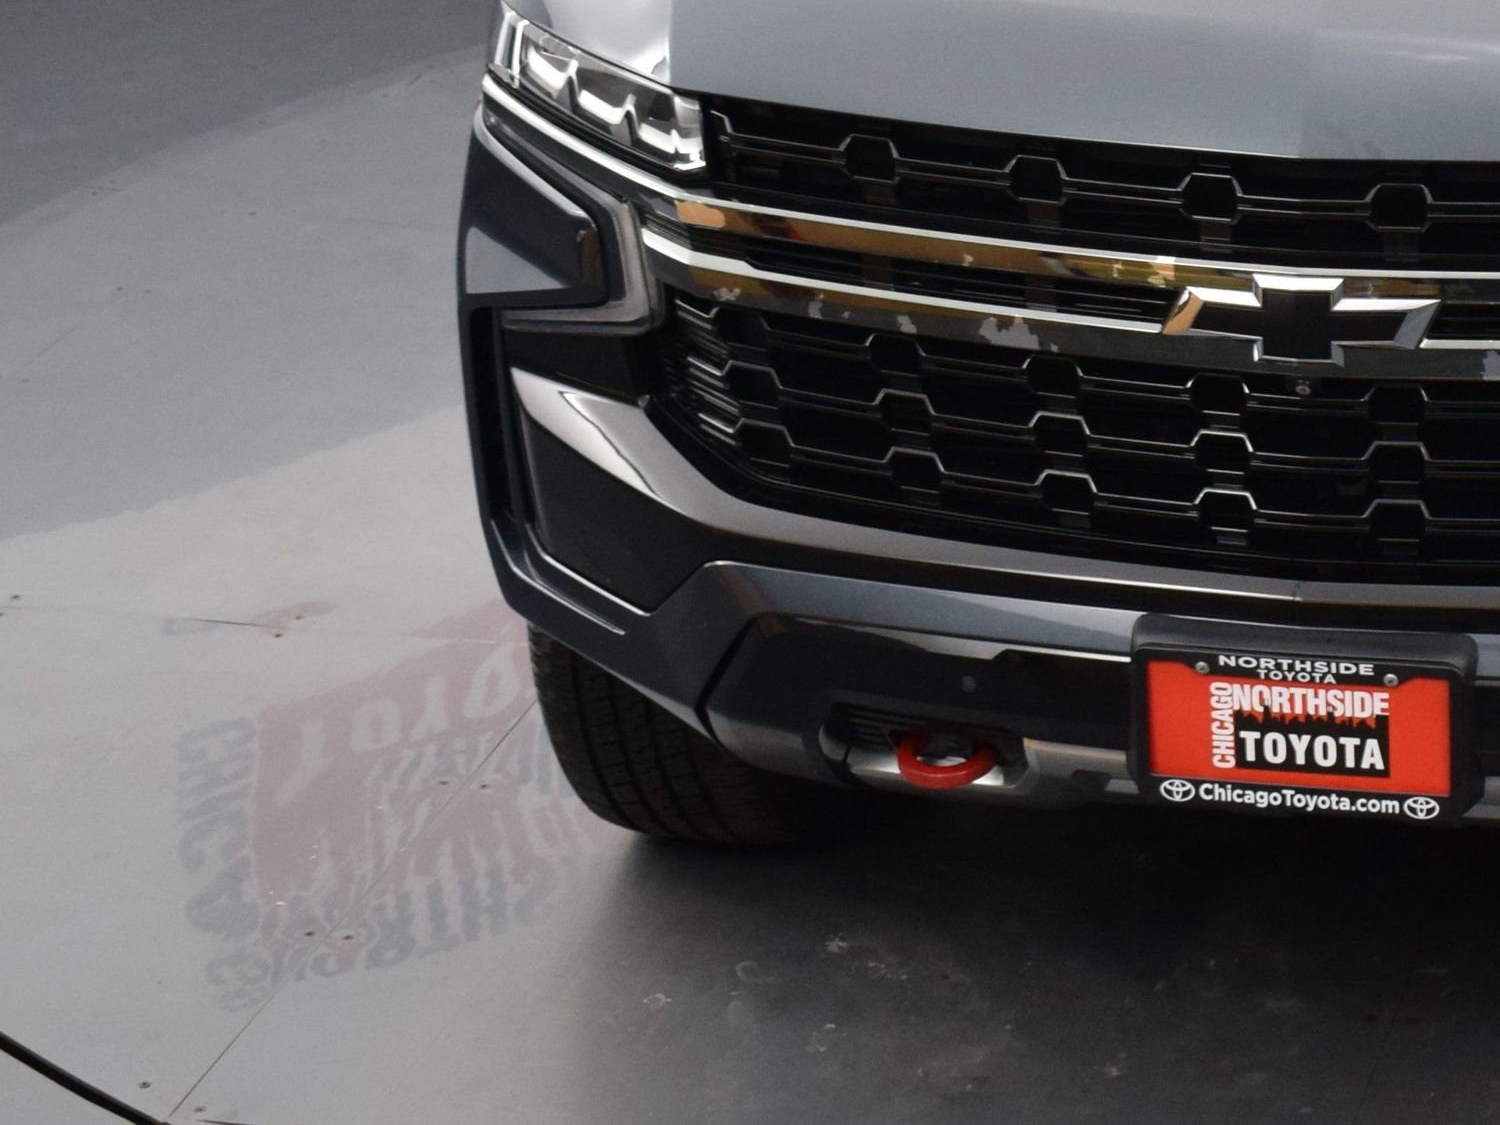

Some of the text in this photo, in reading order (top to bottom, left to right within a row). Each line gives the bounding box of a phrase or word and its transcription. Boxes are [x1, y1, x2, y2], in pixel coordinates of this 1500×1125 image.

[1218, 655, 1374, 676] NORTHSIDE
[1257, 669, 1336, 684] TOYOTA
[1232, 683, 1390, 718] NORTHSIDE
[1209, 682, 1236, 769] CHICAGO
[1239, 730, 1385, 770] TOYOTA
[1199, 783, 1400, 814] ChicagoToyota.com
